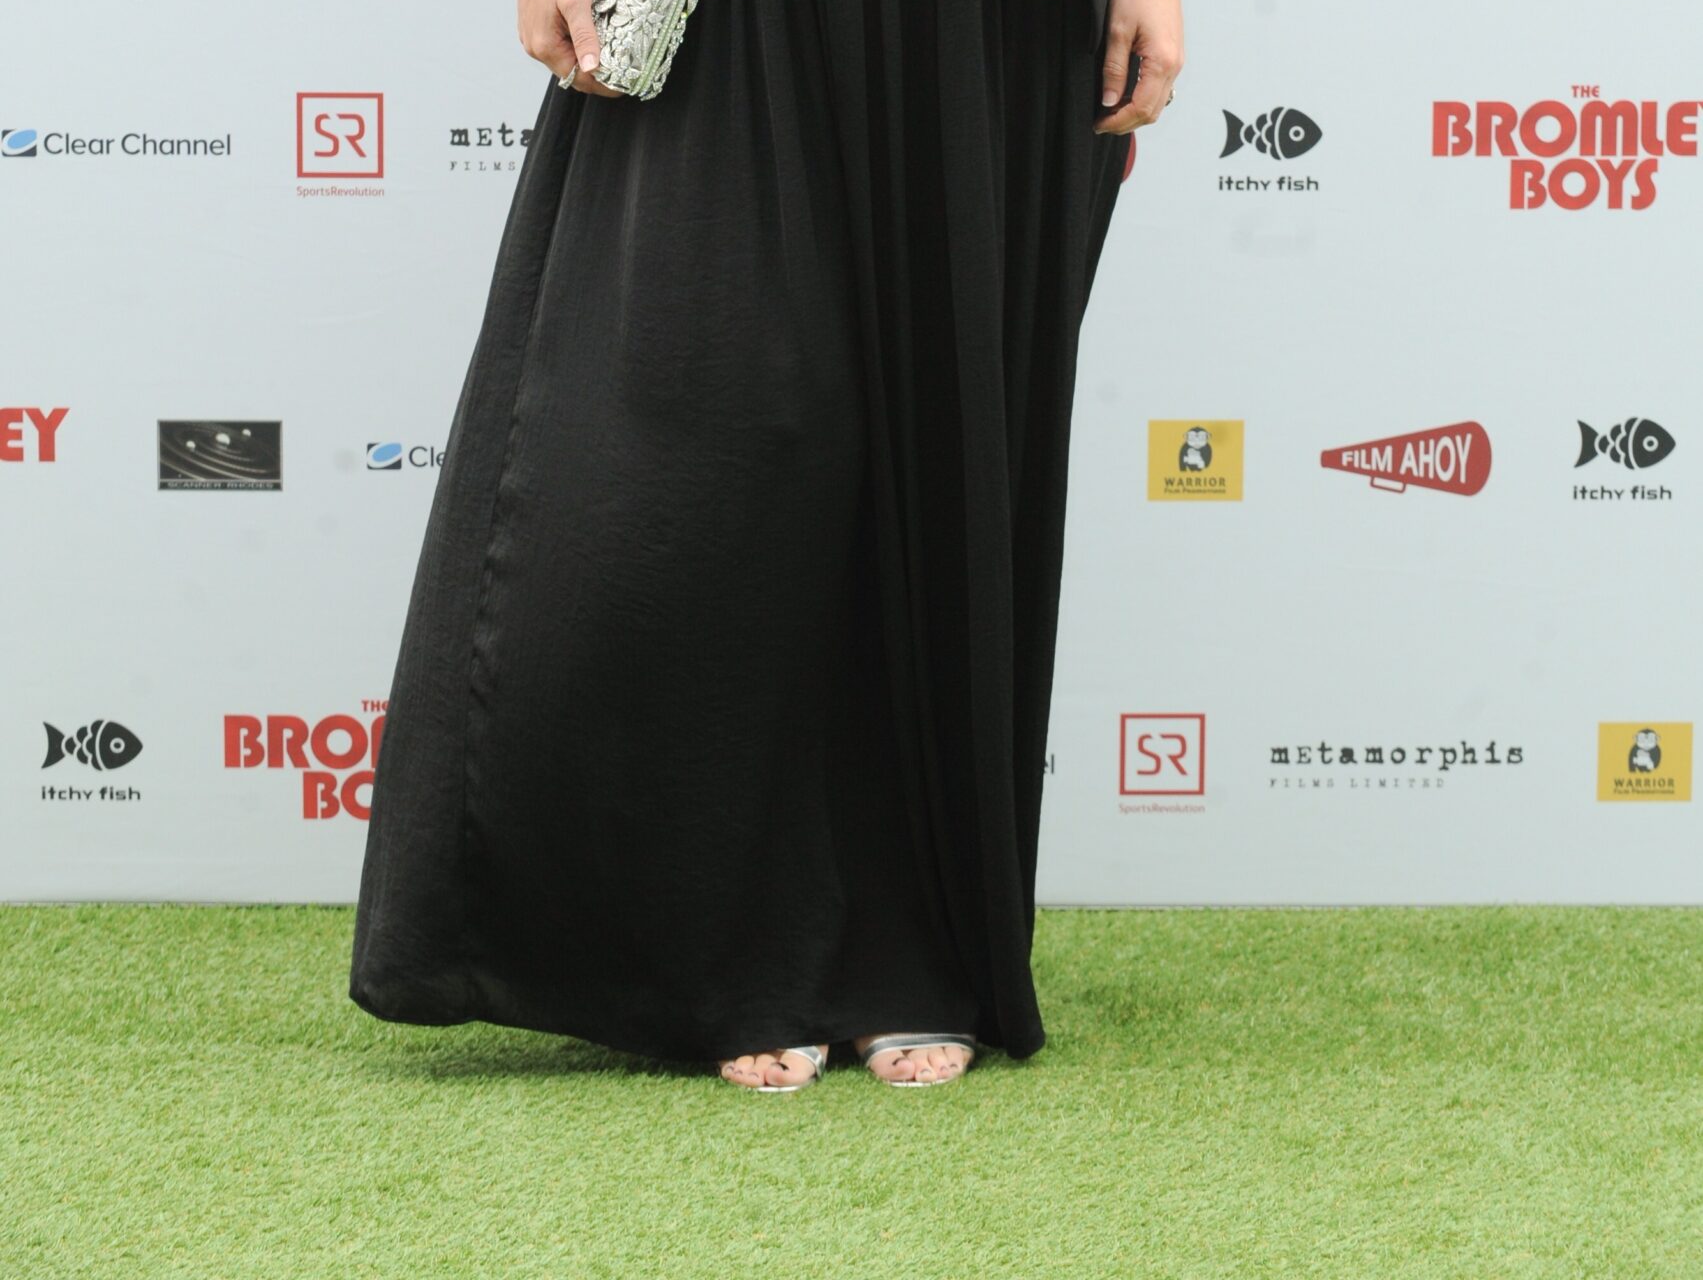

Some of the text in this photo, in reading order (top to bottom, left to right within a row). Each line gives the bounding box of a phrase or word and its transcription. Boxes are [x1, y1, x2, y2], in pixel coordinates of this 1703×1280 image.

[1571, 85, 1599, 98] THE
[314, 114, 366, 158] SR
[1432, 100, 1703, 158] BROMLE
[44, 133, 230, 155] Clear Channel
[450, 161, 515, 171] FILMS
[297, 186, 384, 198] SportsRevolution
[1219, 176, 1318, 191] itchy fish
[1510, 158, 1658, 210] BOYS
[1342, 434, 1471, 483] FILM AHOY
[1165, 478, 1225, 487] WARRIOR
[1573, 486, 1672, 500] itchy fish
[223, 714, 386, 769] BRO
[1137, 734, 1187, 775] SR
[42, 786, 140, 800] itchy fish
